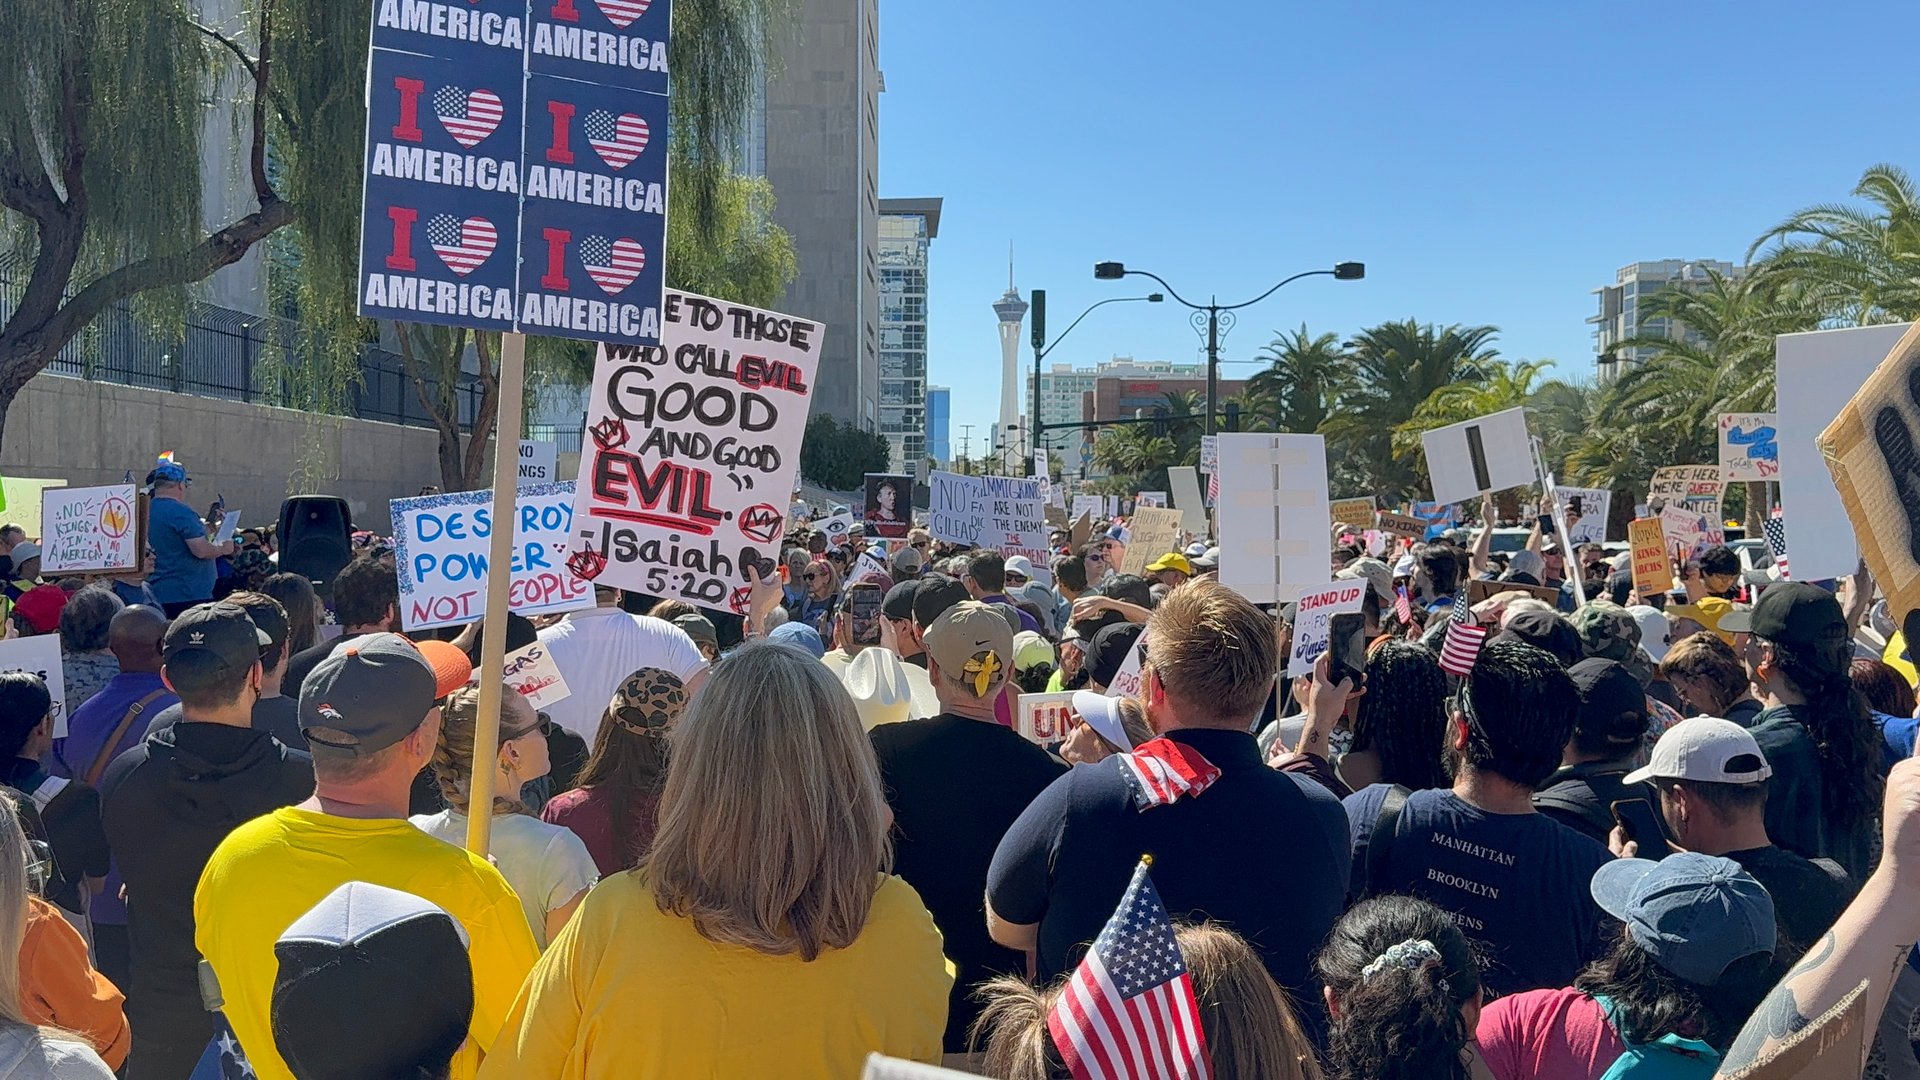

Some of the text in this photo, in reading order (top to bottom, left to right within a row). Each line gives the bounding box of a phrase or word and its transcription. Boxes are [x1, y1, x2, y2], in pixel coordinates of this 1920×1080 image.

[378, 0, 522, 49] AMERICA
[533, 22, 668, 73] AMERICA
[393, 77, 424, 142] I
[546, 101, 576, 164] I
[372, 143, 519, 194] AMERICA
[527, 165, 664, 215] AMERICA
[385, 206, 418, 272] I
[541, 227, 572, 291] I
[365, 273, 515, 321] AMERICA
[522, 293, 660, 340] AMERICA
[684, 297, 723, 331] TO
[727, 307, 815, 353] THOSE
[675, 343, 737, 380] CALL
[736, 354, 808, 396] EVIL
[606, 365, 778, 432] GOOD
[519, 465, 546, 478] NGS
[638, 426, 782, 473] AND GOOD
[55, 521, 89, 538] KINGS
[63, 501, 82, 520] NO
[415, 502, 574, 542] DESROY
[992, 518, 1043, 534] THE ENEMY
[994, 501, 1034, 518] ARE NOT
[1380, 517, 1395, 528] NO
[411, 572, 588, 624] NOT EOPLE
[645, 567, 728, 604] 5:20
[1300, 588, 1360, 612] STAND UP
[1314, 613, 1327, 629] FO
[503, 647, 543, 677] GAS
[1431, 832, 1515, 867] MANHATTAN
[1427, 868, 1499, 899] BROOKLYN
[1449, 911, 1484, 931] EENS
